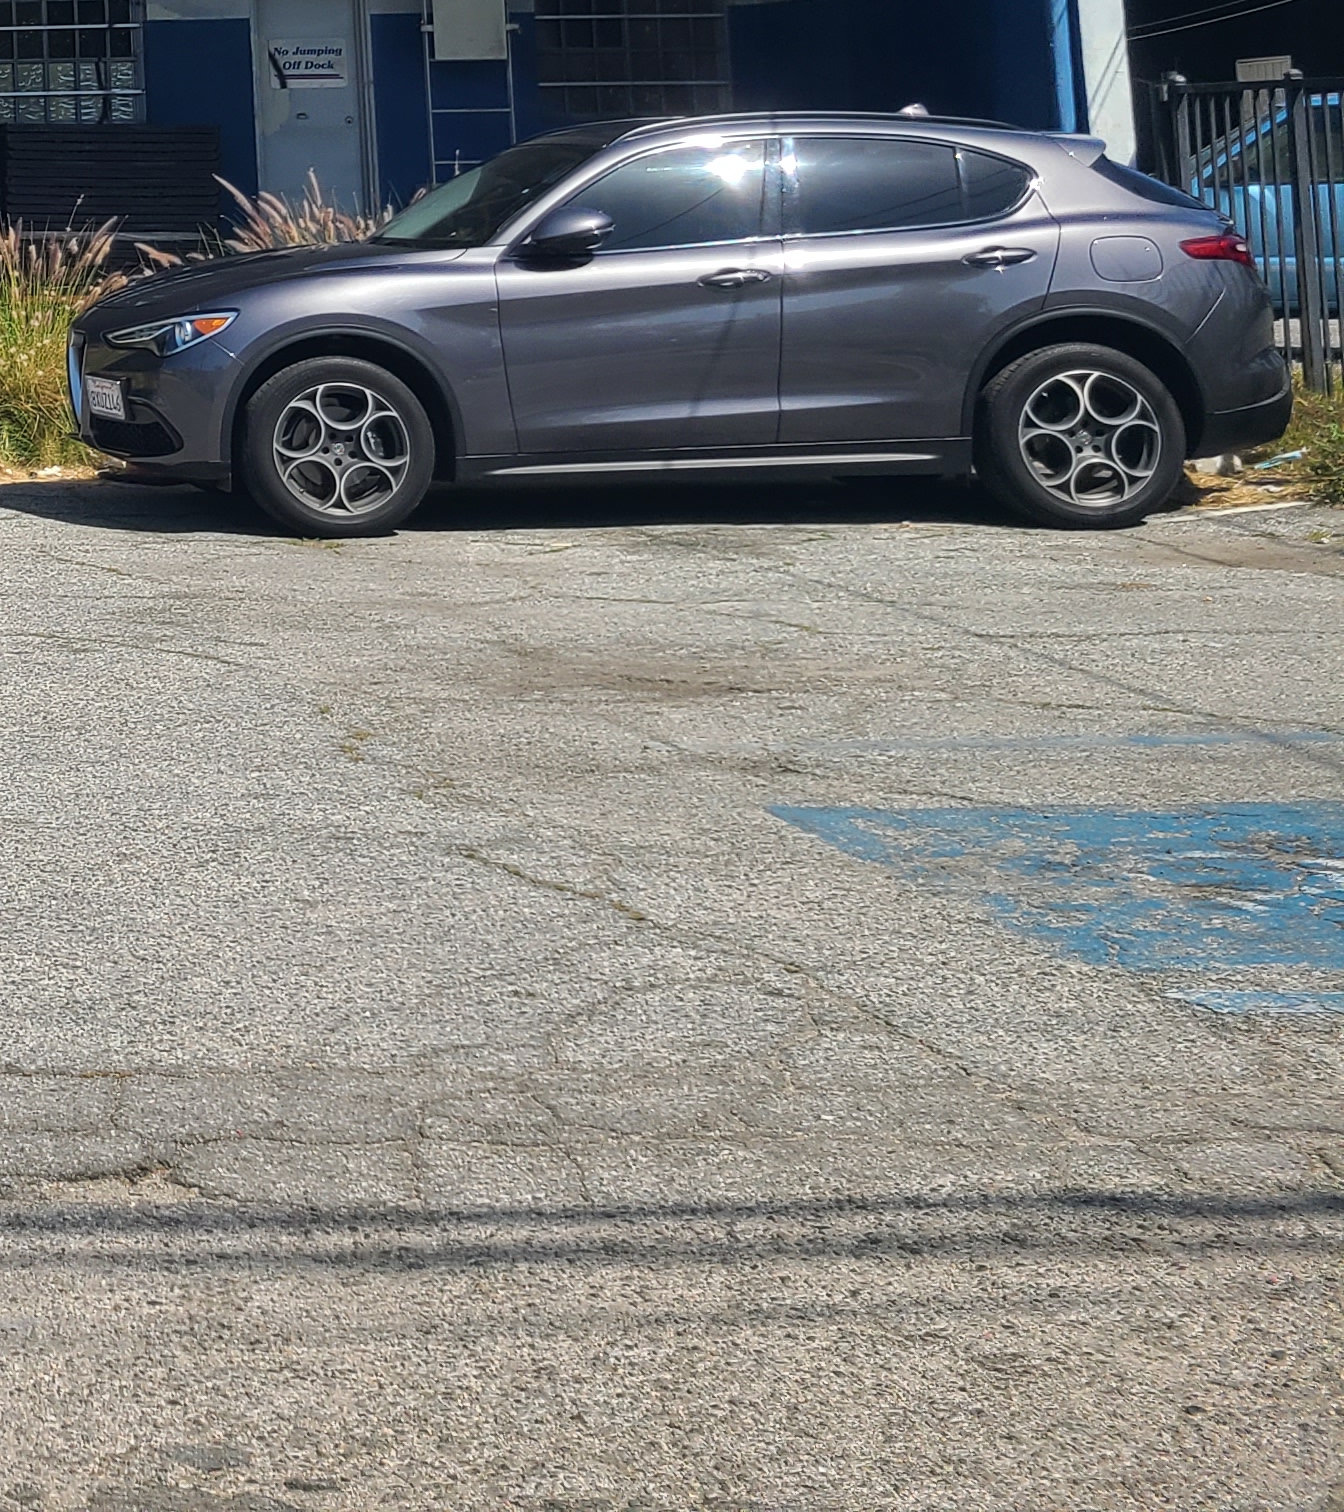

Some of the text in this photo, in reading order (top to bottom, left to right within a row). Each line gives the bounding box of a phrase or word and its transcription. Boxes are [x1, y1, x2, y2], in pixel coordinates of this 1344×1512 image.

[273, 46, 342, 56] No Jumping
[283, 60, 334, 70] Off Dock
